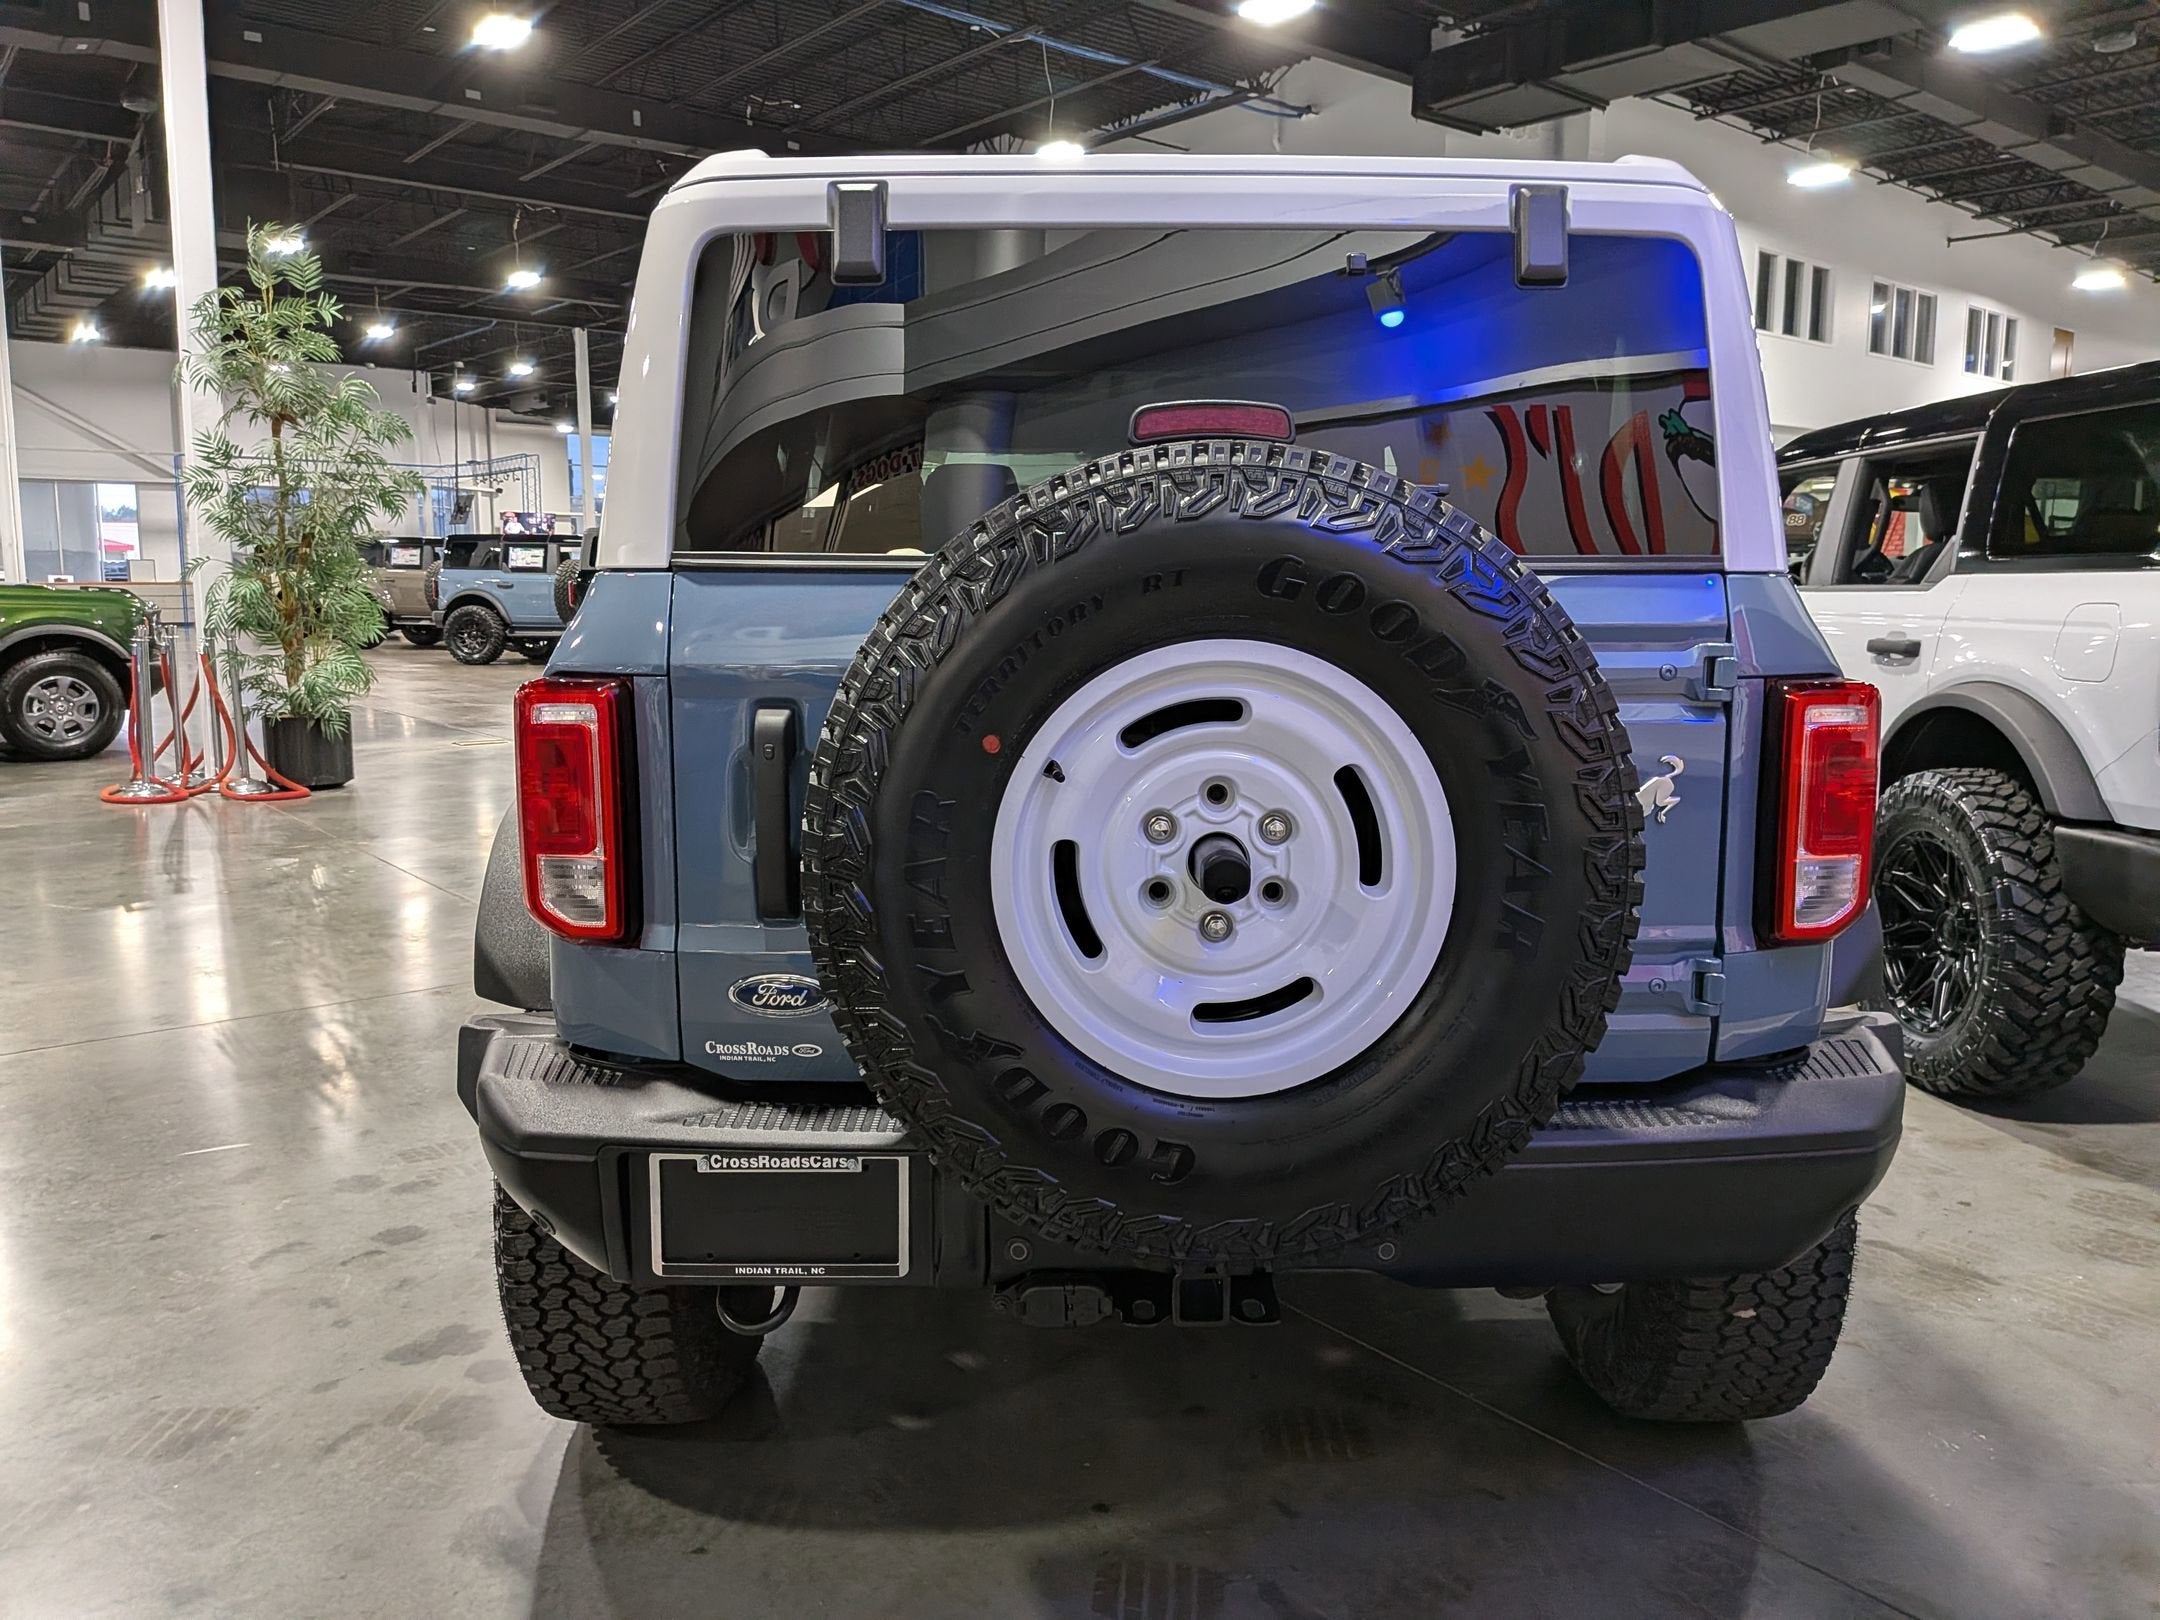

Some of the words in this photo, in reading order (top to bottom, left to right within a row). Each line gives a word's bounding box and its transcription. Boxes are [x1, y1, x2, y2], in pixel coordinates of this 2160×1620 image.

[1786, 513, 1806, 526] 88
[1140, 567, 1191, 595] RT
[752, 983, 808, 1007] Ford
[710, 1154, 847, 1169] CrossRoadsCars
[735, 1267, 771, 1275] INDIAN
[774, 1267, 808, 1276] TRAIL,
[811, 1267, 826, 1275] NC
